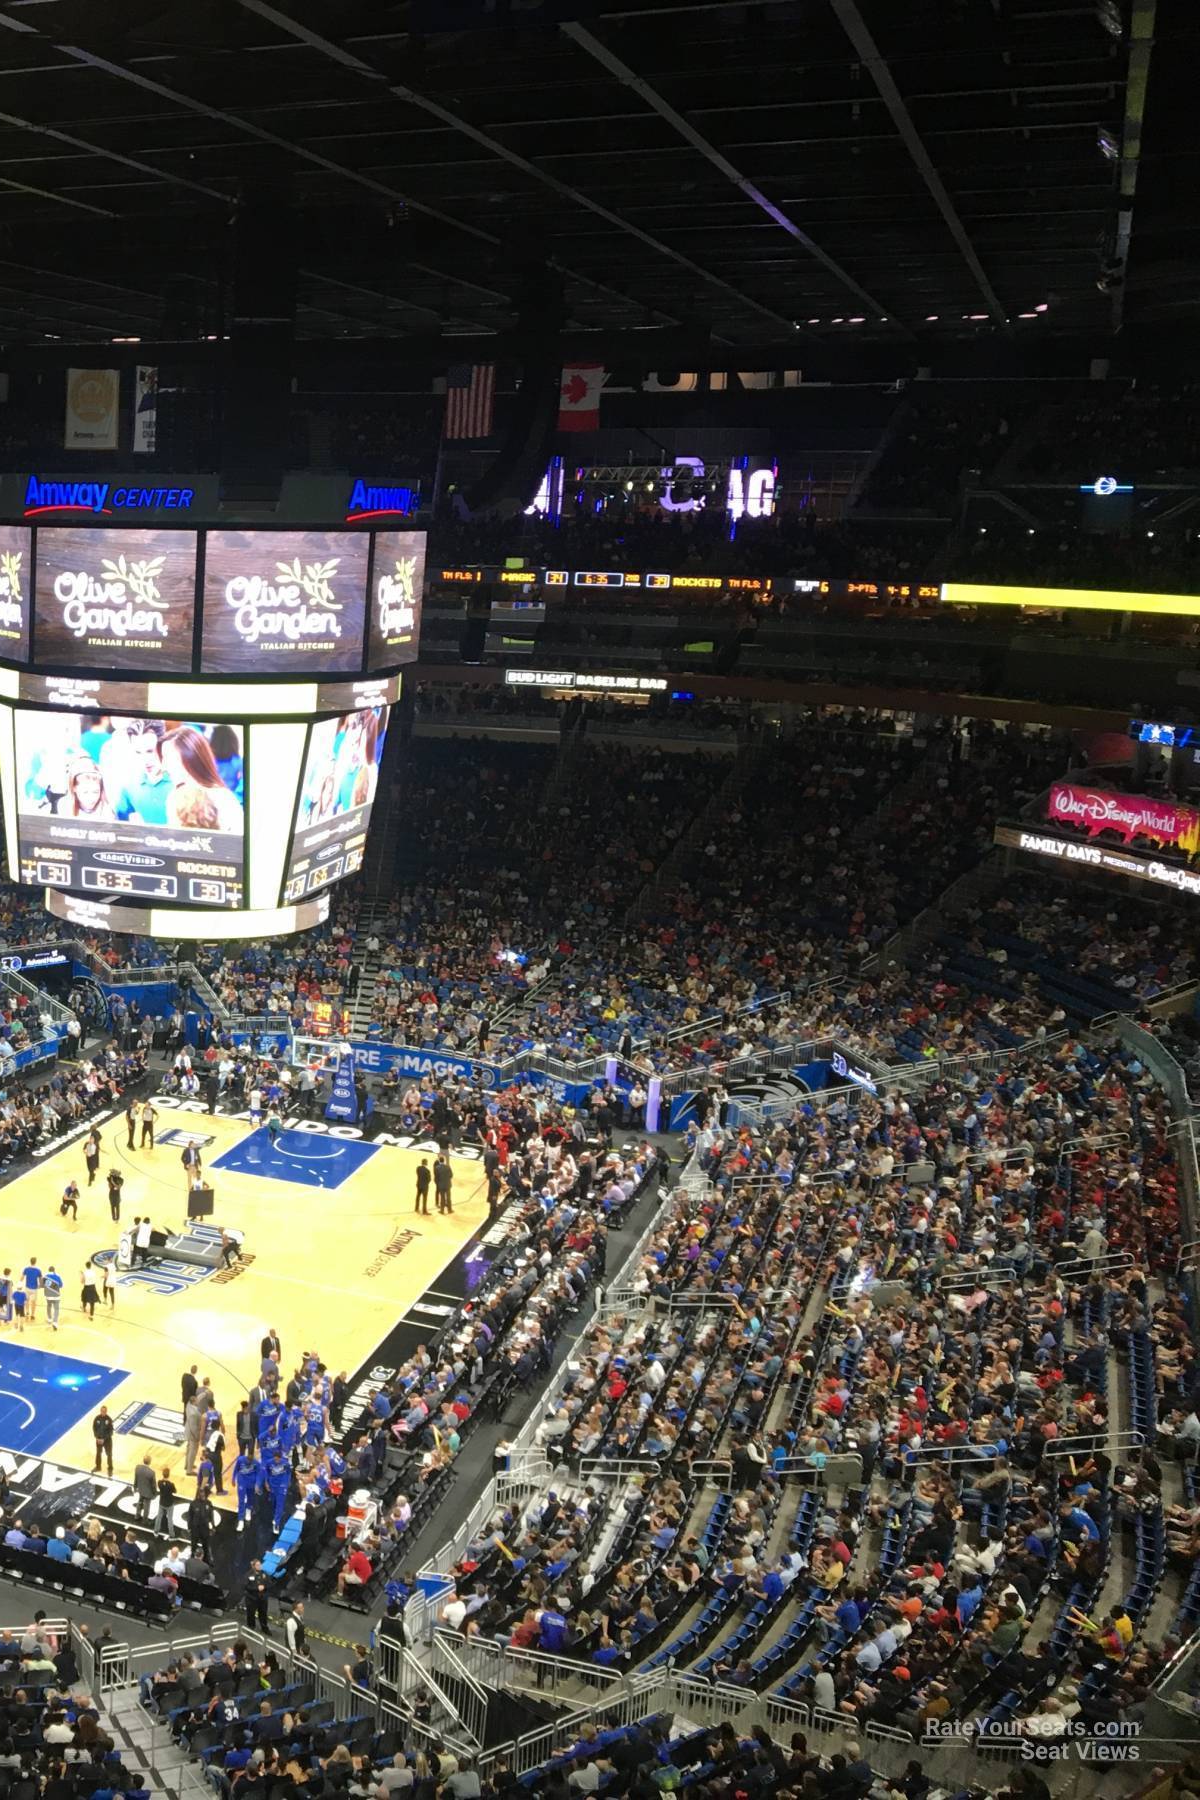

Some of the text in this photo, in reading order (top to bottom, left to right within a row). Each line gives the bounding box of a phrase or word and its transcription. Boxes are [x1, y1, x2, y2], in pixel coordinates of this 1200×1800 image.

[25, 475, 194, 513] Amway CENTER
[53, 571, 126, 604] Olive
[442, 571, 454, 580] TM
[476, 571, 481, 581] 1
[501, 573, 536, 583] MAGIC
[550, 573, 564, 583] 34
[586, 574, 608, 584] 6:35
[653, 575, 669, 586] 39
[672, 577, 722, 588] ROCKETS
[728, 579, 740, 588] TM
[766, 580, 771, 590] 1
[820, 581, 829, 592] 6
[226, 576, 301, 607] Olive
[918, 586, 938, 597] 25%
[64, 603, 169, 638] Garden
[235, 605, 342, 640] Garden
[87, 637, 162, 649] ITALIAN KITCHEN
[260, 642, 294, 651] ITALIAN
[507, 672, 667, 689] BUD LIGHT BASELINE BAR
[1141, 810, 1175, 833] World
[34, 847, 72, 860] MAGIC
[1019, 834, 1067, 856] FAMILY
[1067, 845, 1102, 864] DAYS
[1103, 855, 1137, 872] PRESENTED
[1137, 864, 1146, 873] BY
[48, 866, 66, 882] 34
[177, 861, 236, 877] ROCKETS
[97, 871, 168, 889] 6:35 2
[201, 883, 219, 900] 39
[404, 1055, 467, 1079] MAGIC
